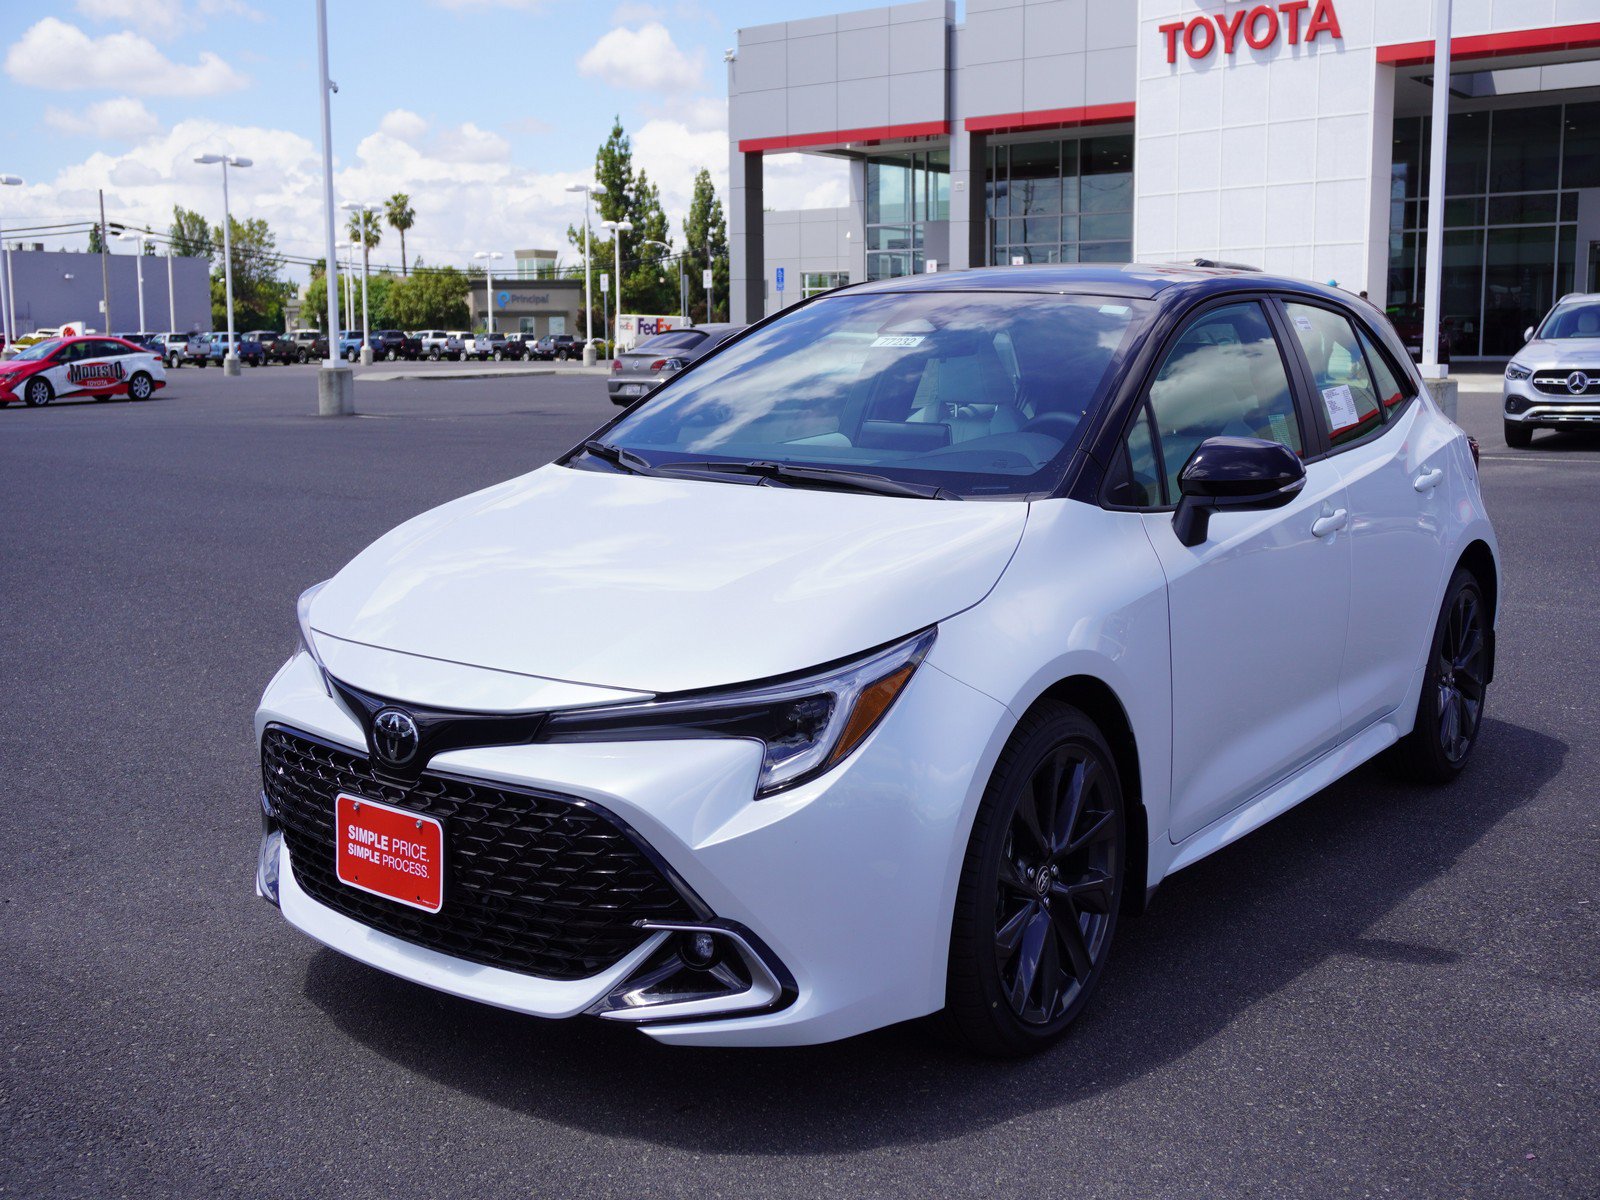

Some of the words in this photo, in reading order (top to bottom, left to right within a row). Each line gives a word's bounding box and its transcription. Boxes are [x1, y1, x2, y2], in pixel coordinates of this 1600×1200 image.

[1158, 0, 1342, 64] TOYOTA
[511, 294, 549, 305] Principal
[879, 338, 917, 346] 77232
[70, 361, 122, 383] MODESTO
[348, 824, 389, 851] SIMPLE
[391, 838, 430, 862] PRICE.
[348, 842, 380, 864] SIMPLE
[382, 854, 430, 879] PROCESS.
